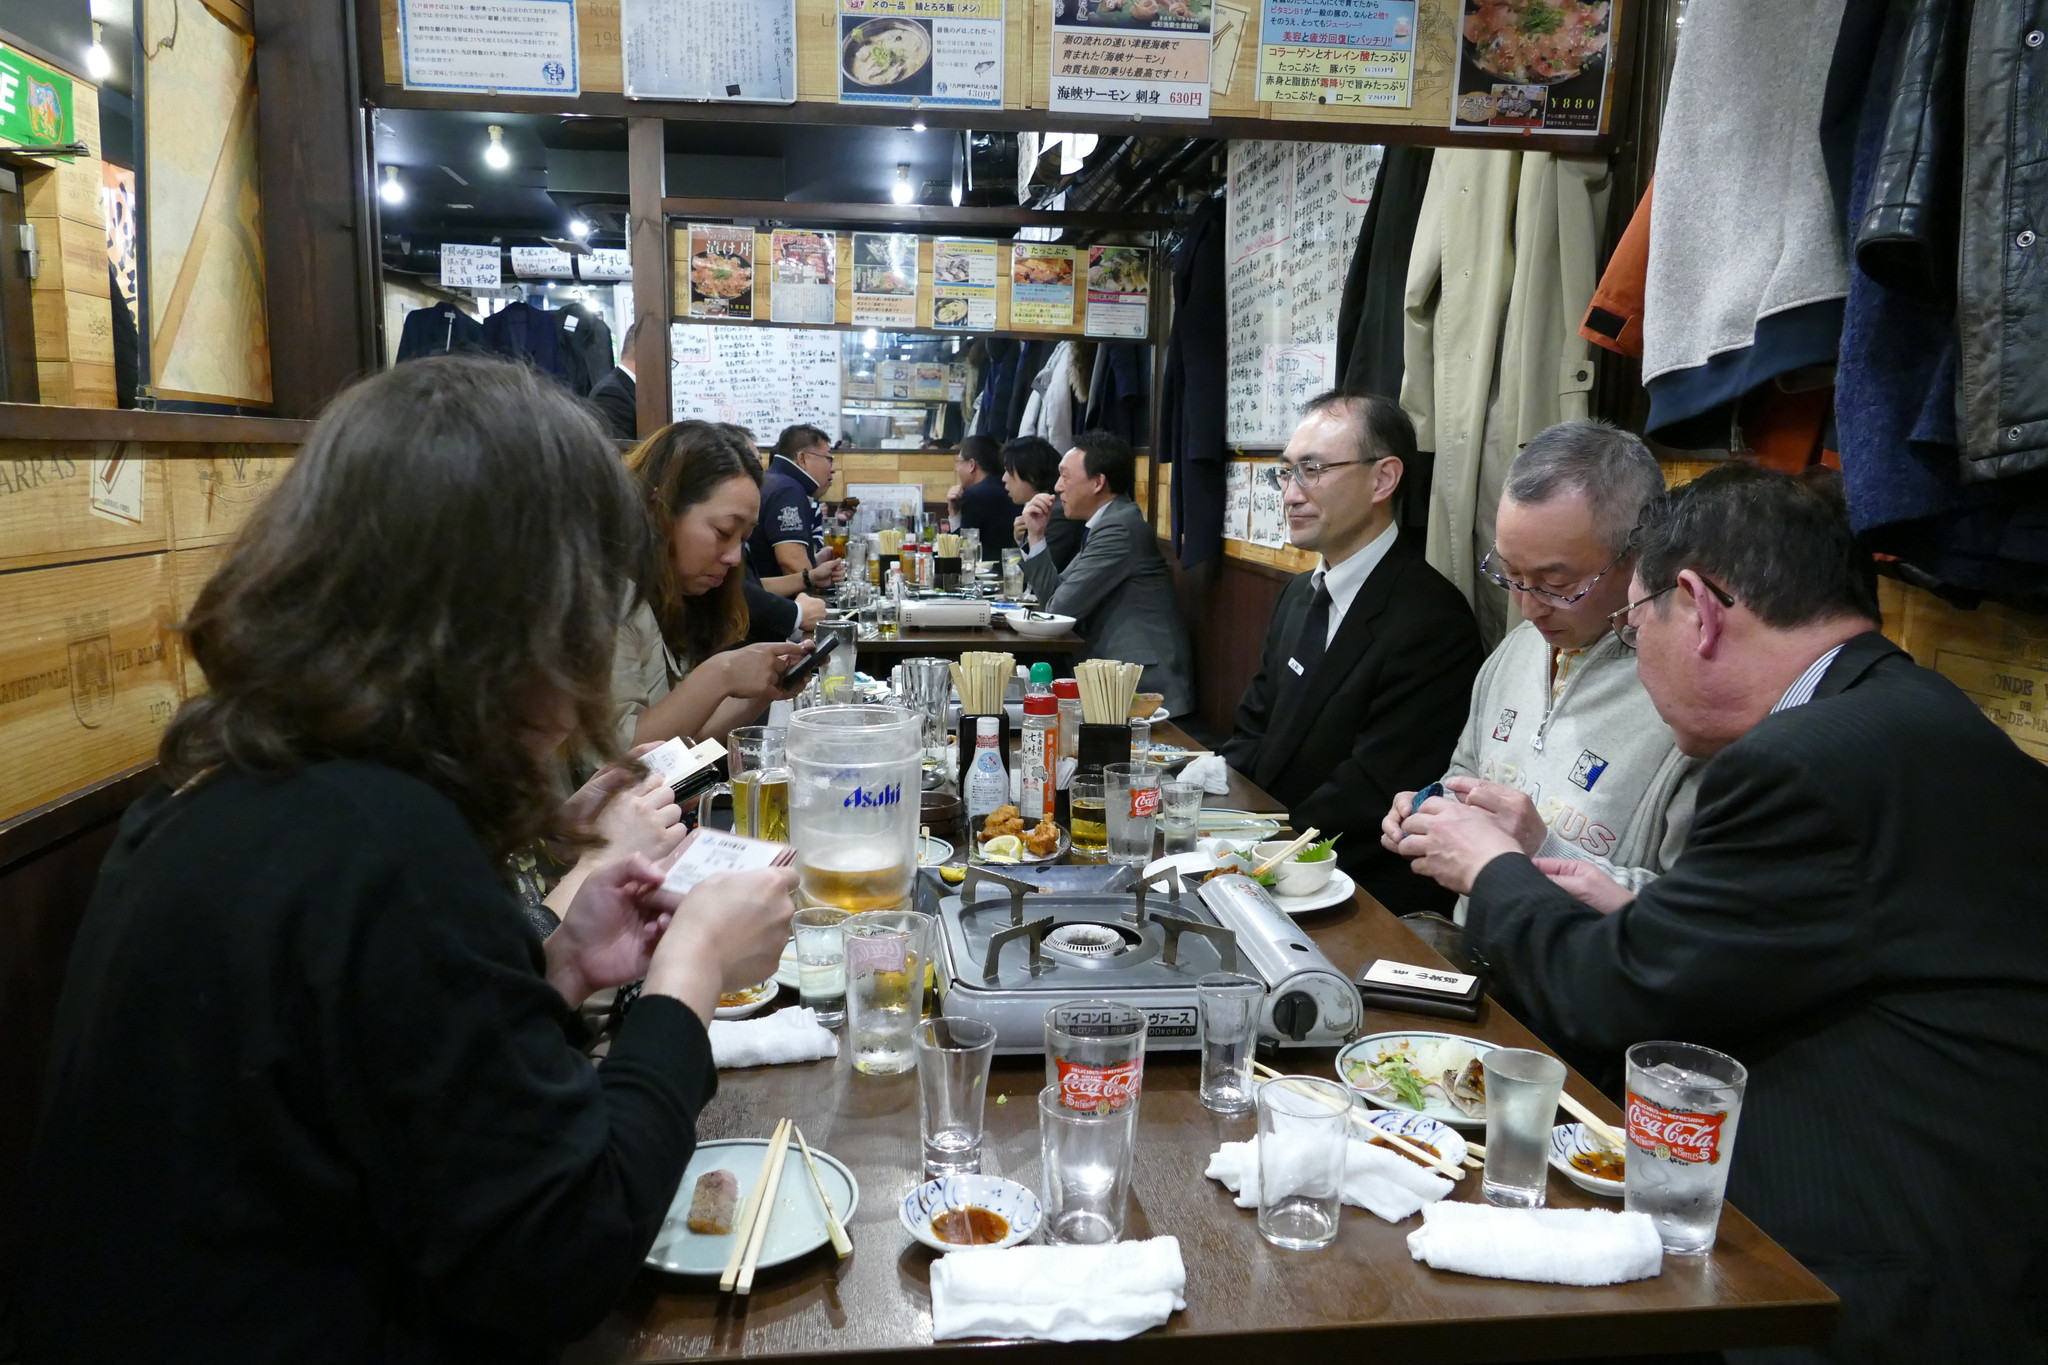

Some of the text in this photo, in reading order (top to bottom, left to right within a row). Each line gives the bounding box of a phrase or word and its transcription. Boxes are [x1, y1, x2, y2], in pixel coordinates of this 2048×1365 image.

[1062, 34, 1180, 50] 潮の流れの速い津軽海峡で
[1062, 49, 1166, 65] 育まれた「海峡サーモン」
[1269, 47, 1407, 63] コラーゲンとオレイン酸たっぷり
[1278, 61, 1320, 73] たっこぶた
[1329, 64, 1356, 75] 豚バラ
[1266, 75, 1406, 91] 赤身と脂肪が霜降りで旨みたっぷり
[1057, 85, 1202, 106] 海峡サーモン 刺身 630円
[1275, 89, 1317, 101] たっこぶた
[1336, 93, 1361, 103] ロース
[1031, 246, 1069, 256] たっこぶた
[1028, 733, 1037, 756] 七味
[843, 782, 901, 808] Asahi
[1628, 1104, 1716, 1148] Coca-Cola
[1667, 1113, 1706, 1124] REFRESHING
